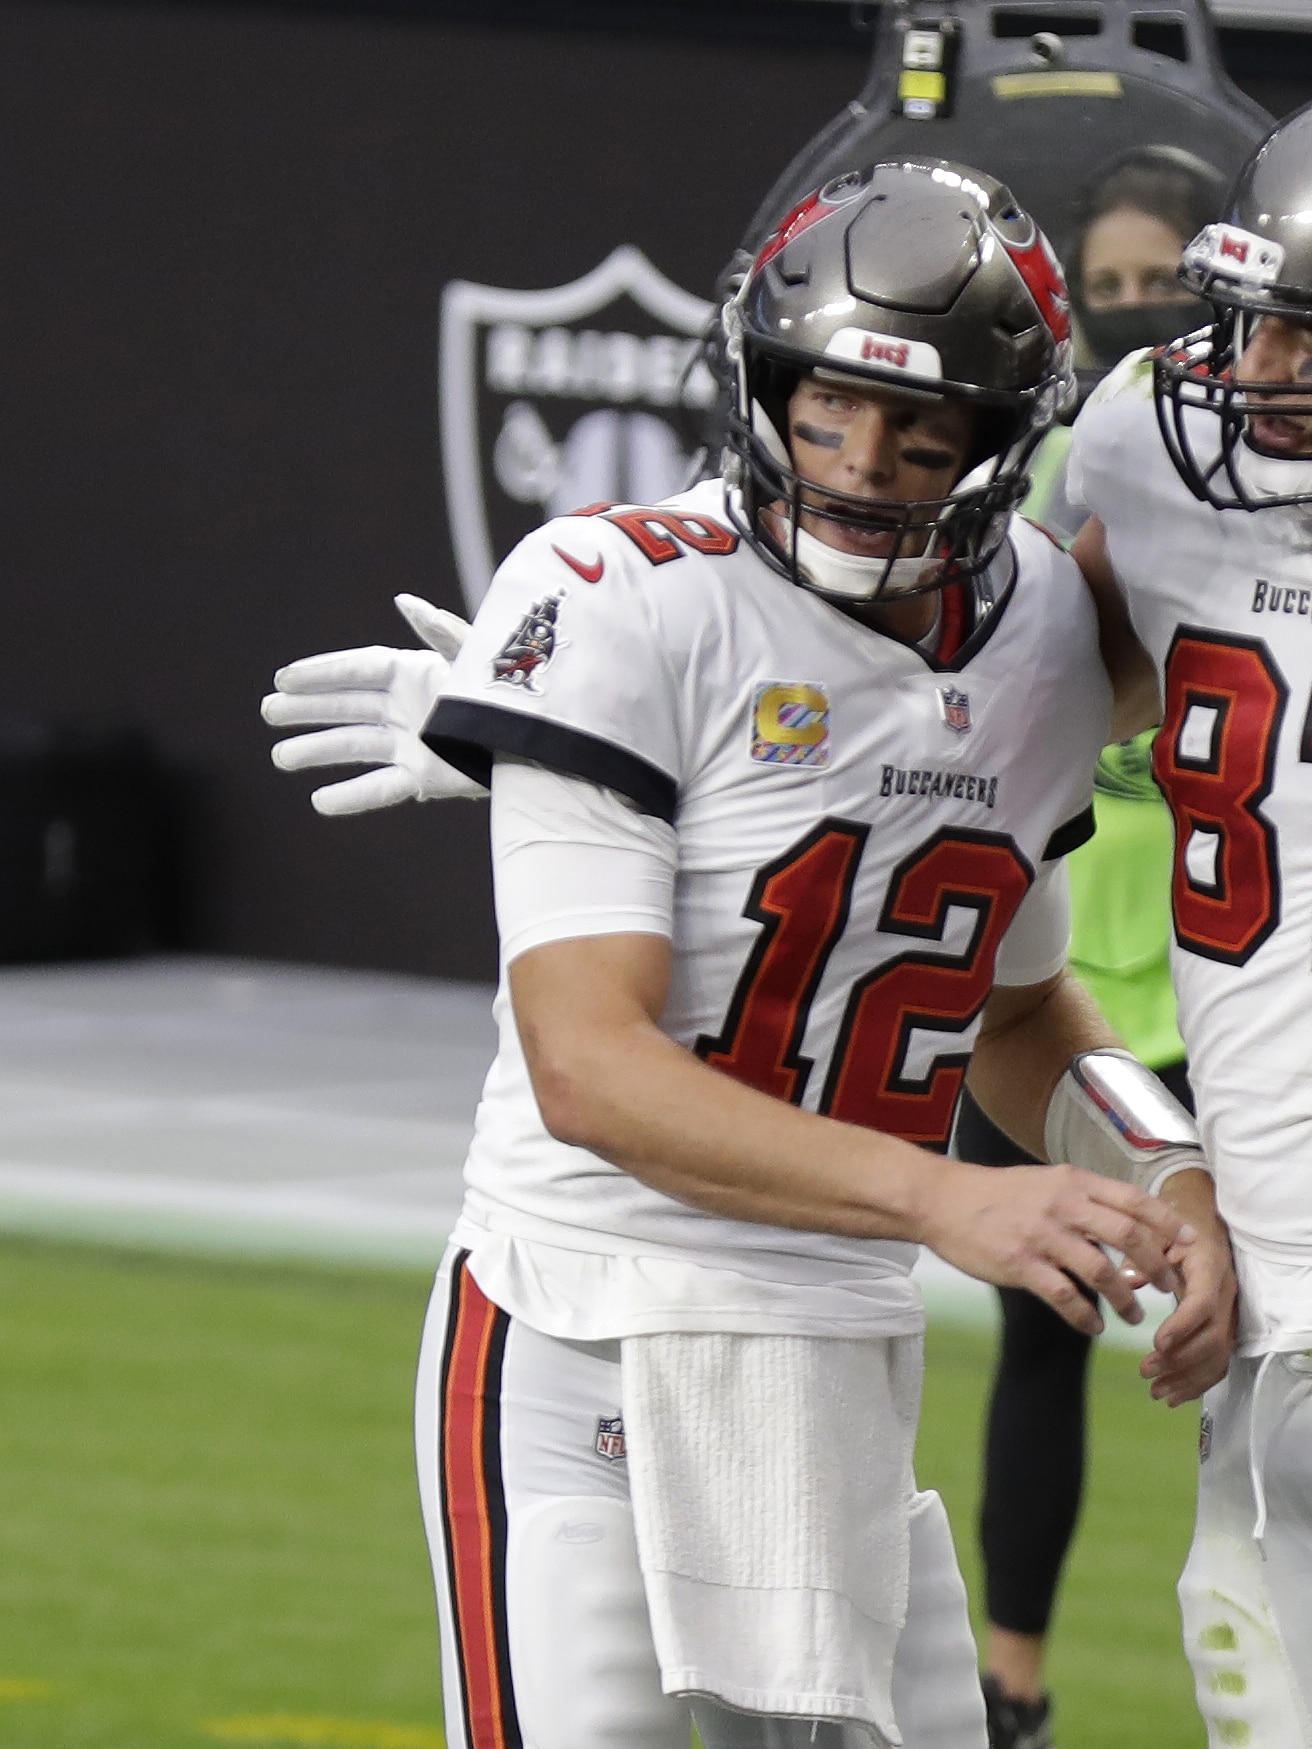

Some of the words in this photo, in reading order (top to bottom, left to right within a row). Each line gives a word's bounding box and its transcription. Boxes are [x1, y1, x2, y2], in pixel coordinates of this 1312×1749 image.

[486, 326, 718, 410] RAIDE
[879, 764, 999, 809] BUCCANEERS
[695, 815, 1035, 1155] 12
